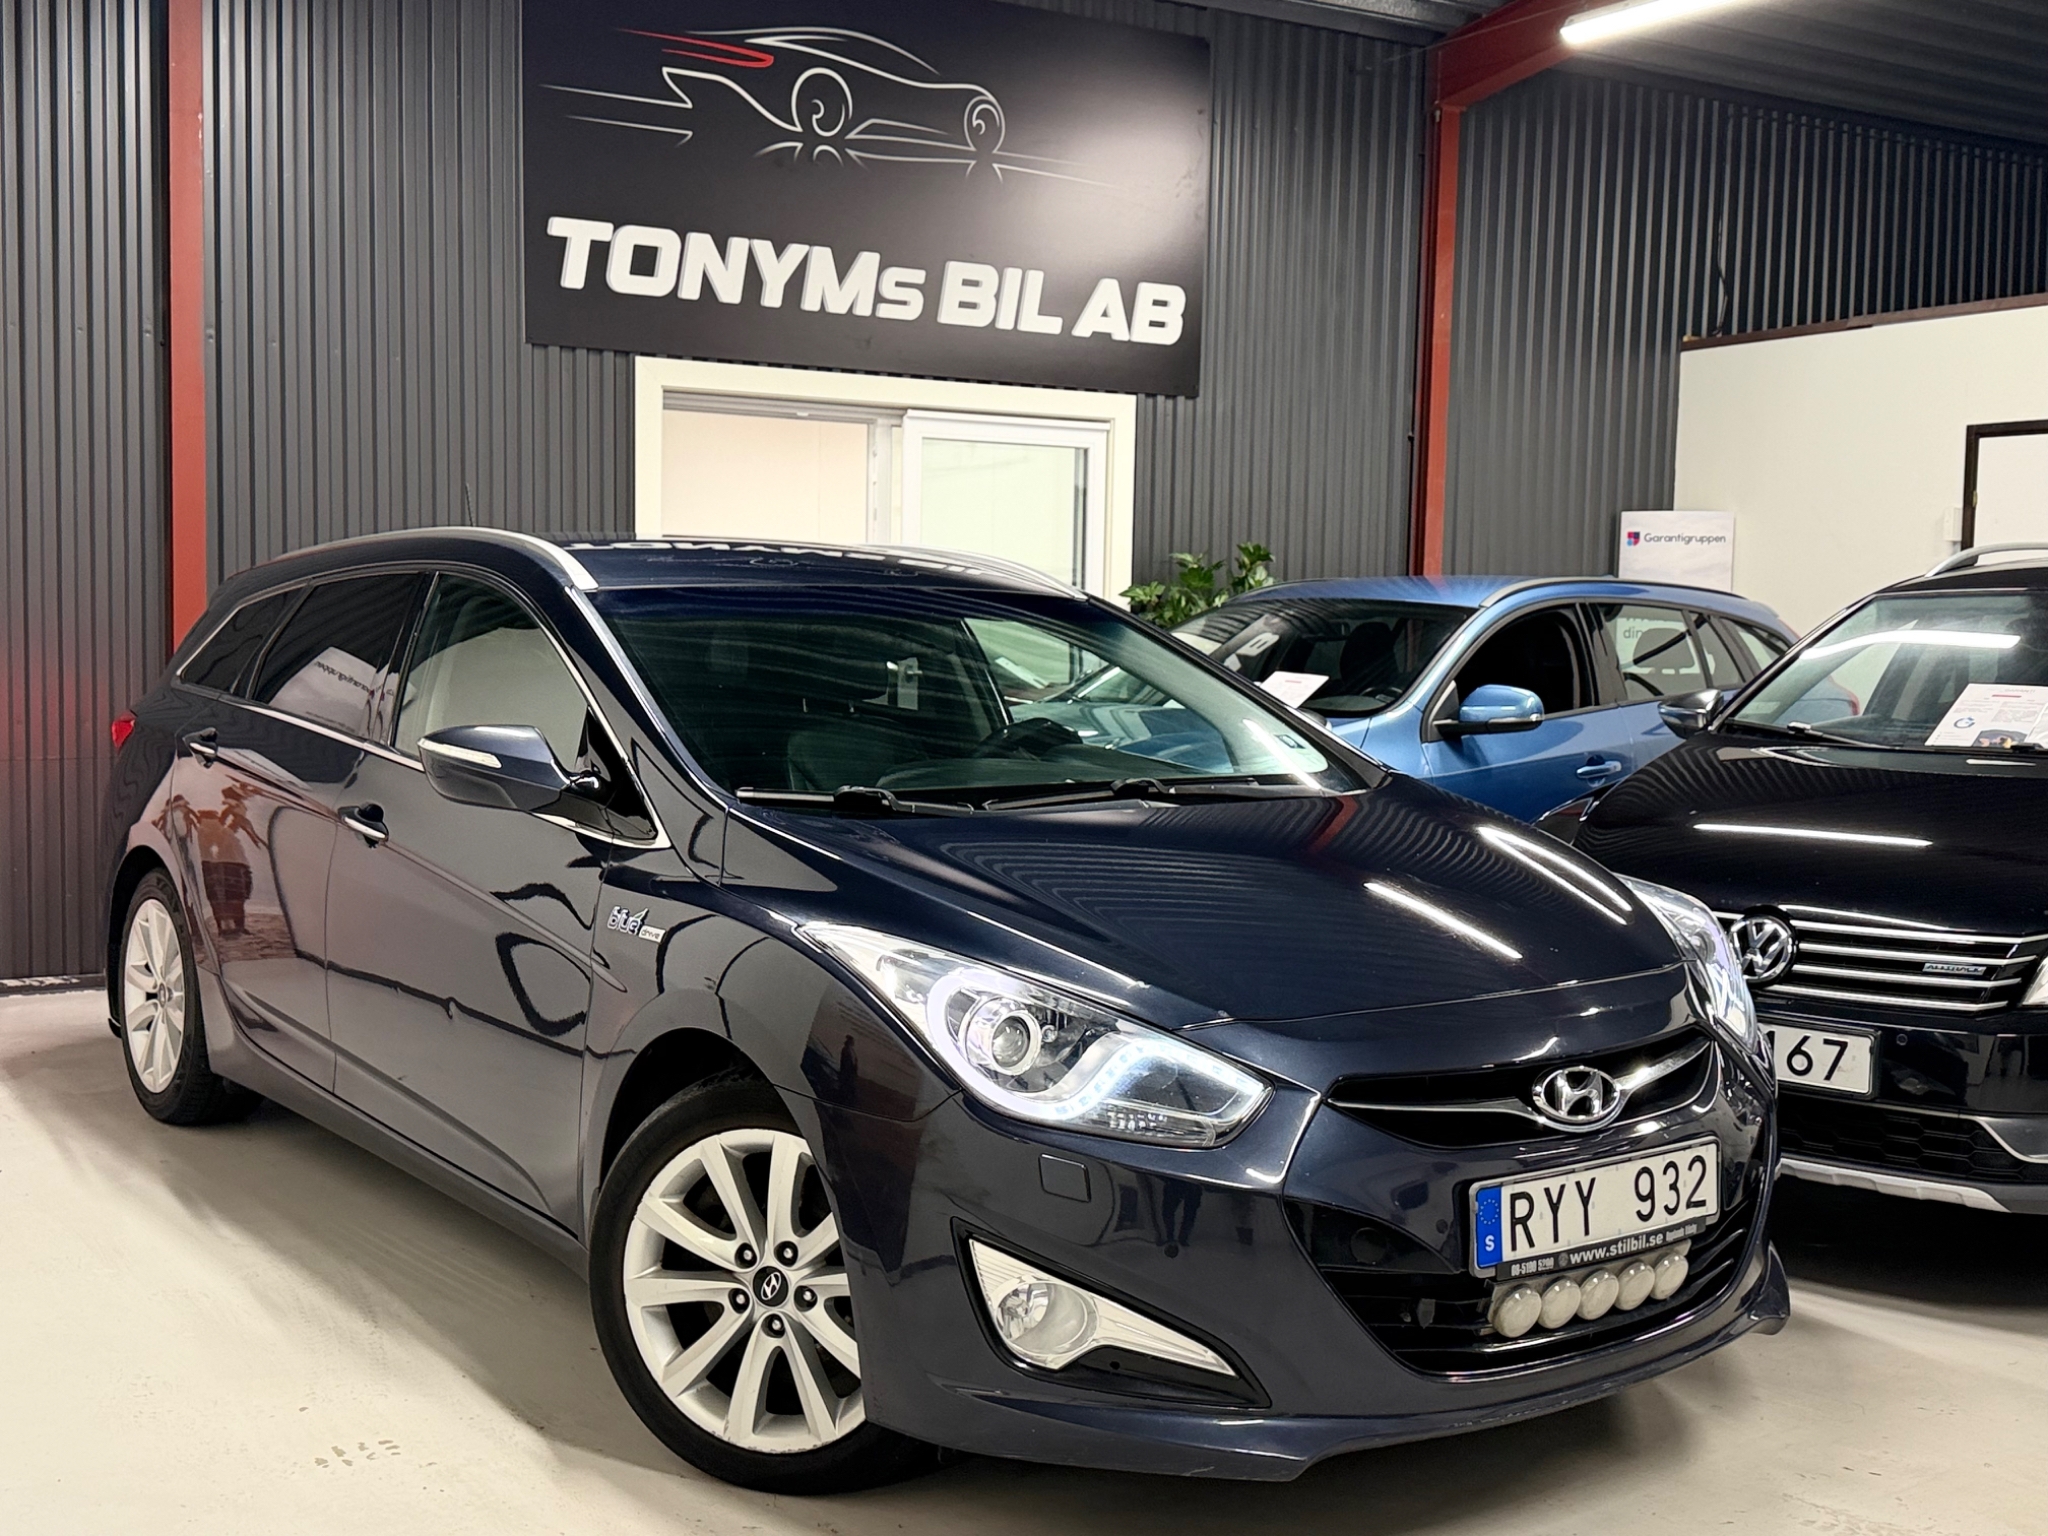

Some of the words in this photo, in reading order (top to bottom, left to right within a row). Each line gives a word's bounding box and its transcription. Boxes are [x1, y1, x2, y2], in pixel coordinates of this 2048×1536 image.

[547, 216, 927, 322] TONYMs
[936, 260, 1063, 334] BIL
[1071, 277, 1187, 345] AB
[1643, 533, 1726, 546] Garantigruppen
[1509, 1177, 1596, 1252] RYY
[1634, 1154, 1707, 1222] 932
[1485, 1234, 1495, 1252] S
[1570, 1232, 1664, 1265] www.stilbil.se
